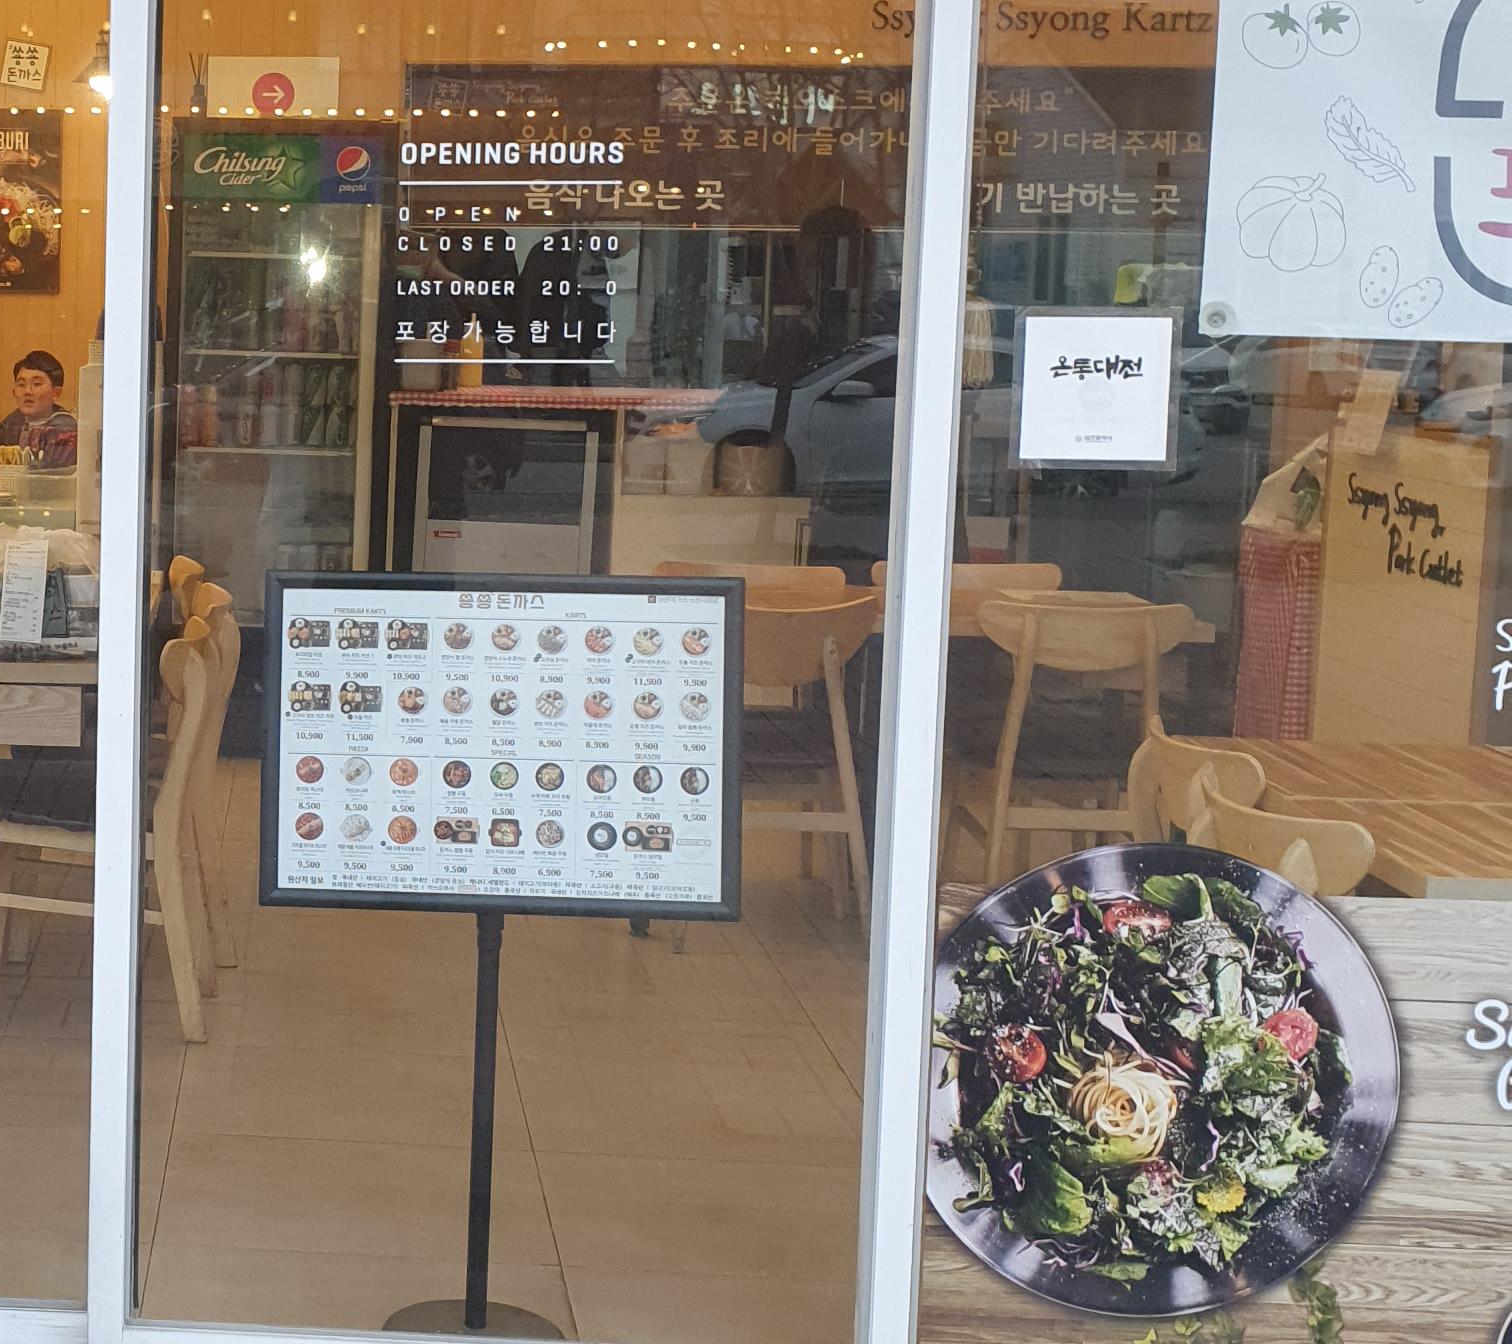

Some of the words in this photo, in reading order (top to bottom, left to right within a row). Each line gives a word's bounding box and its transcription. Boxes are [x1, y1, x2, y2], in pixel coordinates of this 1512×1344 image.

[996, 1, 1111, 40] Ssyong
[1123, 2, 1214, 33] Kartz
[7, 67, 42, 83] 돈까스
[677, 127, 703, 153] 후
[715, 127, 798, 153] 조리에
[401, 142, 520, 165] OPENING
[530, 142, 624, 164] HOURS
[219, 173, 262, 186] Cider
[338, 184, 367, 193] pepsi
[524, 179, 583, 210] 음식
[595, 181, 686, 210] 나오는
[695, 180, 725, 211] 곳
[1016, 183, 1139, 215] 반납하는
[1150, 184, 1181, 216] 곳
[398, 236, 516, 251] CLOSED
[543, 236, 618, 251] 21:00
[397, 281, 443, 295] LAST
[450, 281, 515, 295] ORDER
[1050, 355, 1143, 380] 온통대전
